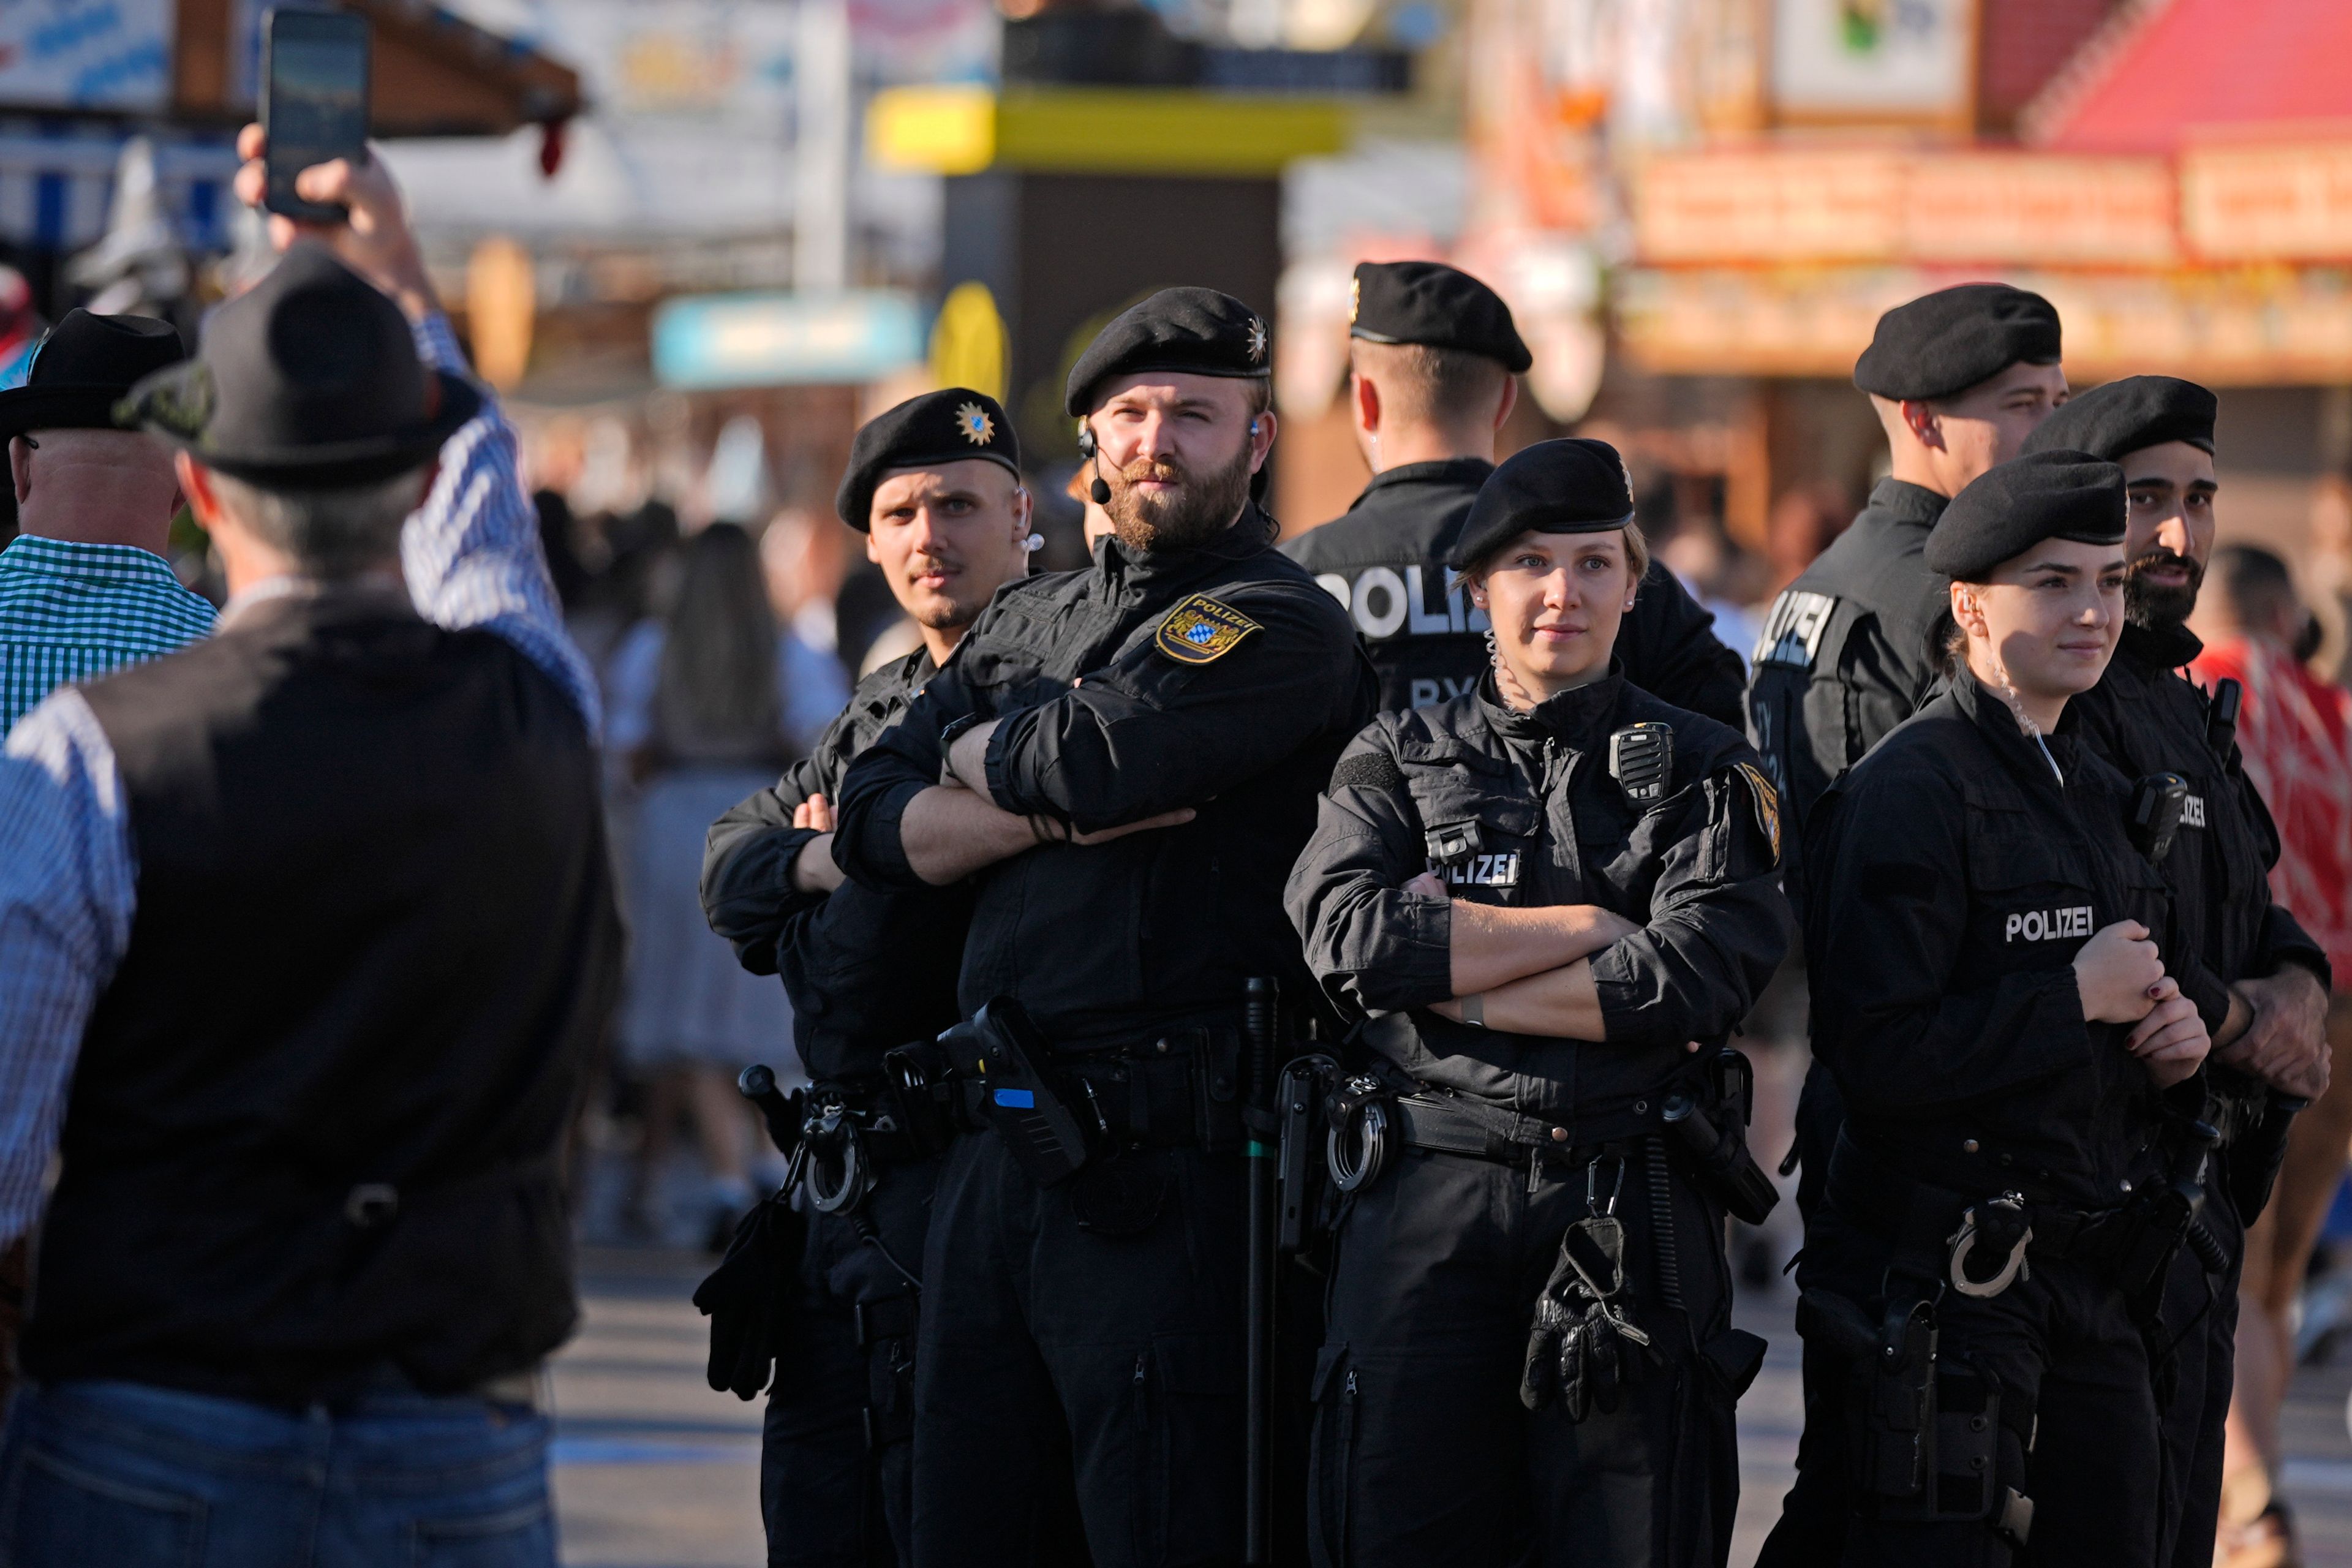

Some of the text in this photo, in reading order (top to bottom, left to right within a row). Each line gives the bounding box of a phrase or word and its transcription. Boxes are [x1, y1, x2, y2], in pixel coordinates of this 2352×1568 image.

[1193, 599, 1253, 628] POLIZEI
[1315, 565, 1491, 639] OLI
[2006, 906, 2094, 943] POLIZEI
